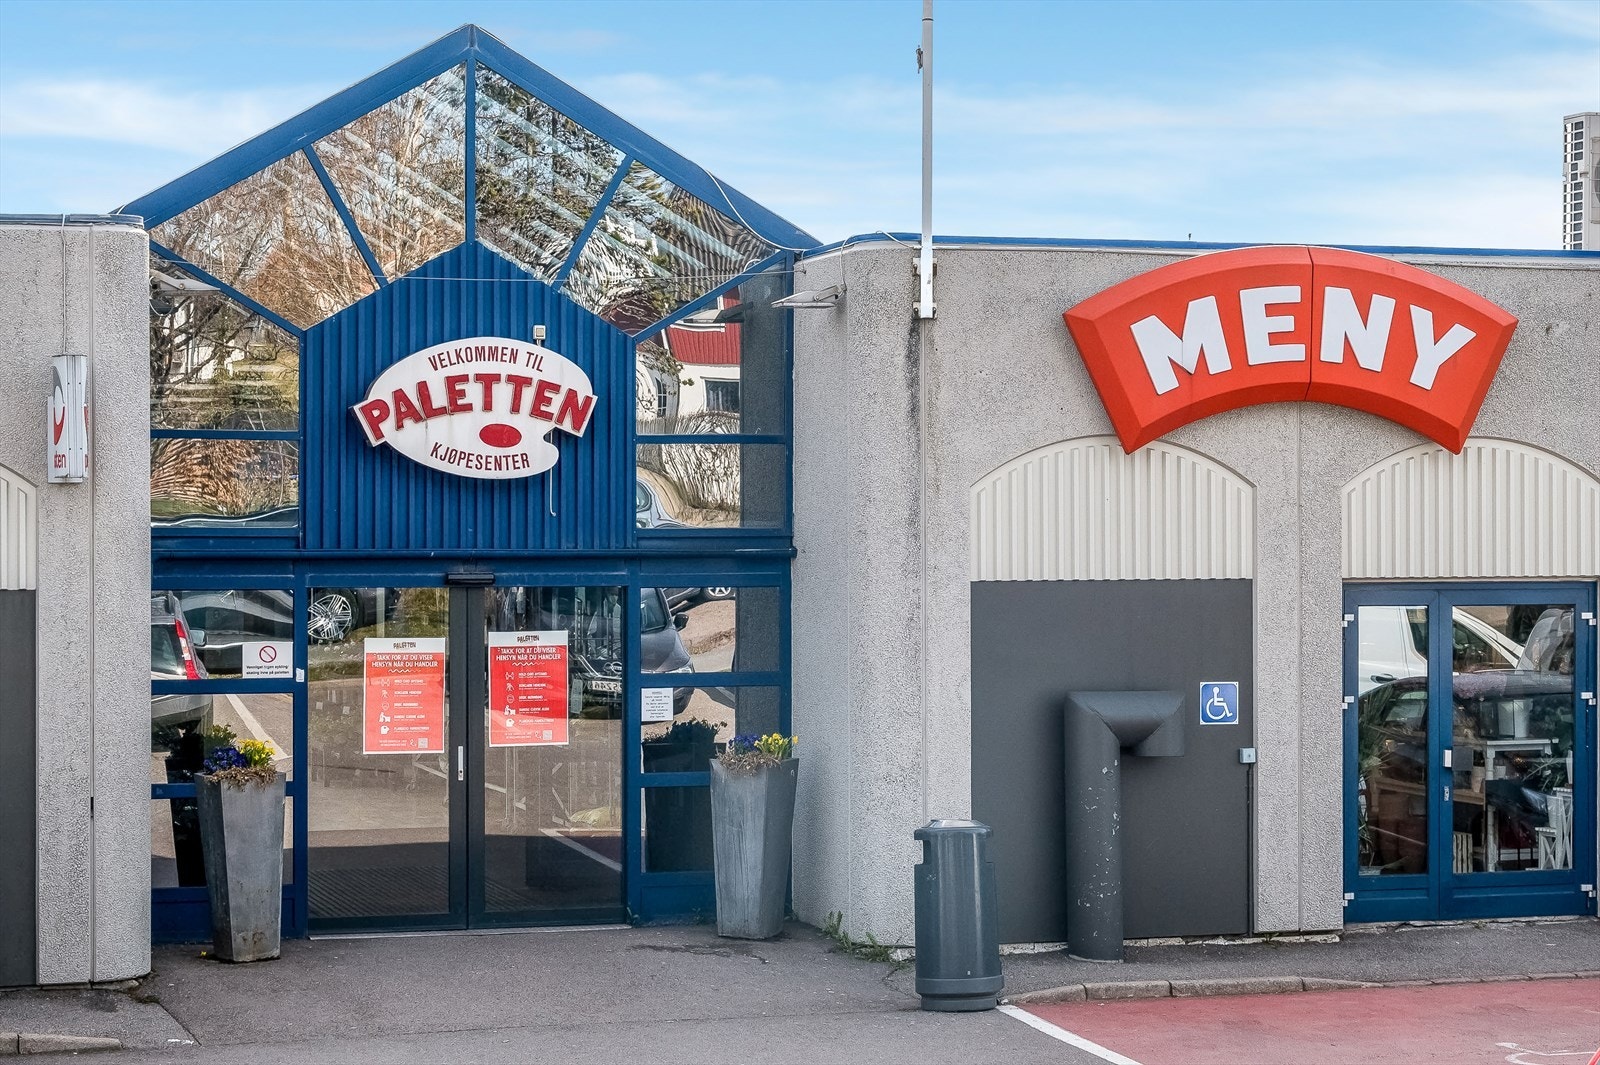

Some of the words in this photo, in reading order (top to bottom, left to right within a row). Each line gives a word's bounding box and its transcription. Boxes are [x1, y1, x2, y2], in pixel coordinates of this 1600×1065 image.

[1130, 285, 1477, 395] MENY
[428, 345, 519, 371] VELKOMMEN
[526, 351, 545, 373] TIL
[359, 373, 595, 442] PALETTEN
[430, 442, 531, 472] KJØPESENTER
[393, 660, 405, 668] NÅR
